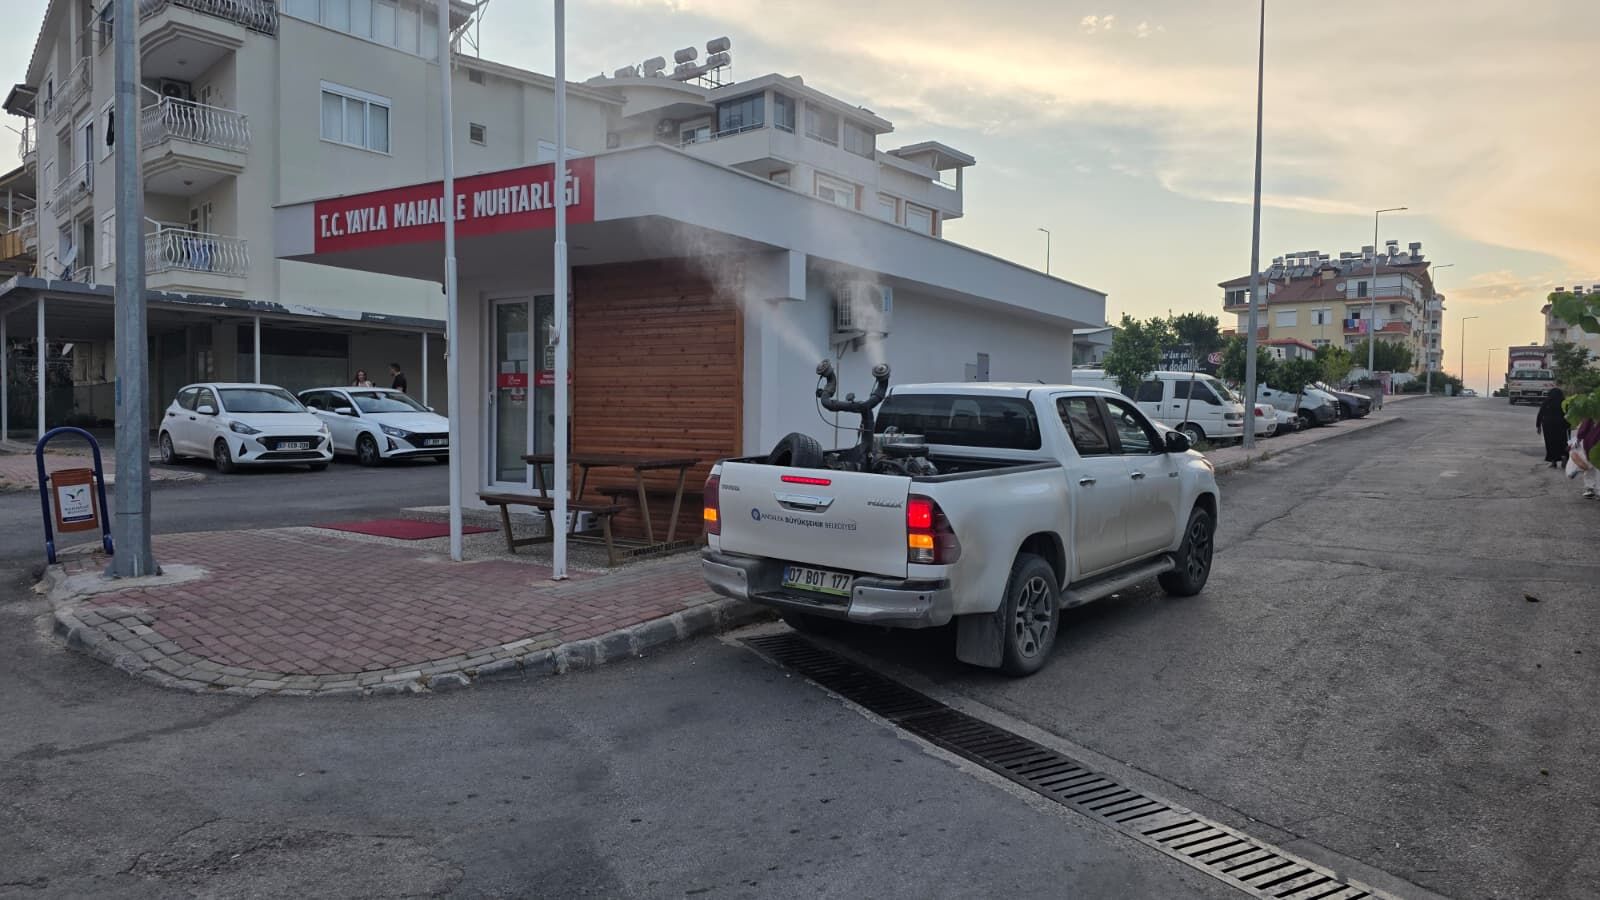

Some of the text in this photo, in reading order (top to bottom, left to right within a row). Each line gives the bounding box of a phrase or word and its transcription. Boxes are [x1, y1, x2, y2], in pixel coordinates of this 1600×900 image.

[320, 168, 580, 238] T.C. YAYLA MAHALE MUHTARLĞI
[789, 568, 850, 590] 07 BOT 177
